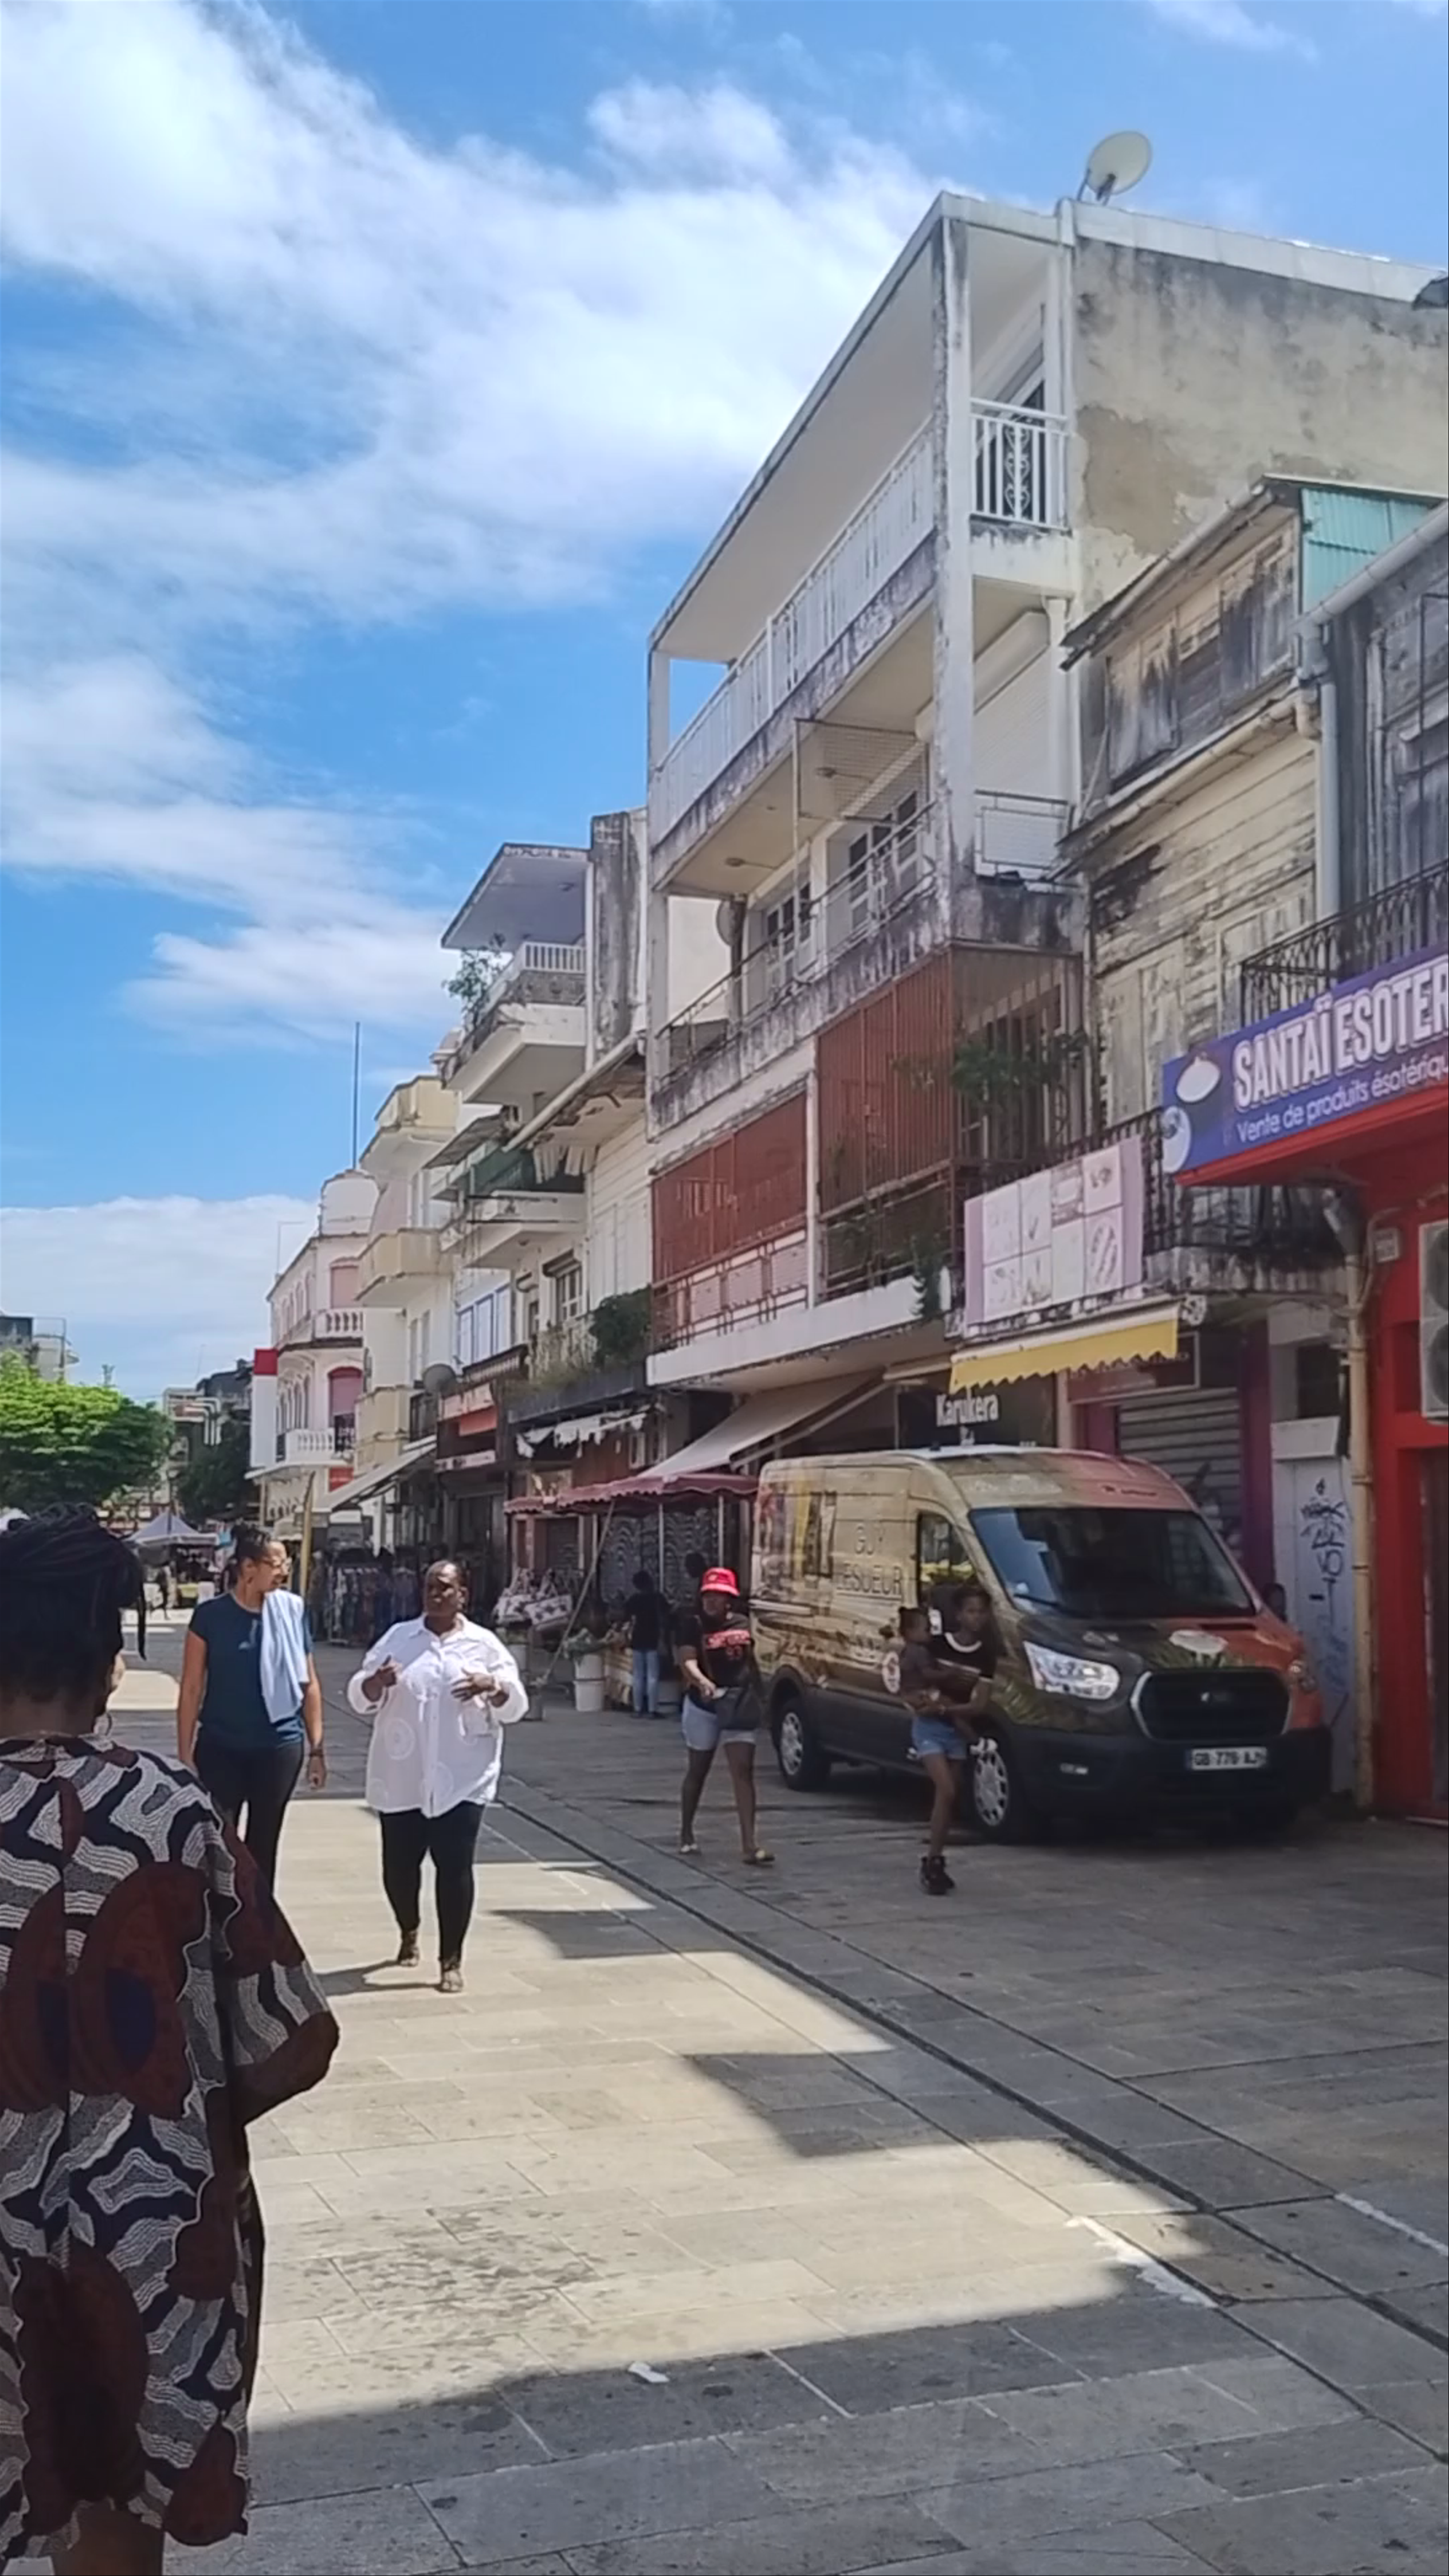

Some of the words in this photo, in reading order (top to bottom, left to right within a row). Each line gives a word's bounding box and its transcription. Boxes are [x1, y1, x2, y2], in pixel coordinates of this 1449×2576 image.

[1233, 993, 1333, 1112] SANTAÏ
[1236, 1113, 1281, 1143] Vente
[1283, 1103, 1304, 1128] de
[1306, 1079, 1369, 1125] produits
[936, 1394, 999, 1426] Karukera
